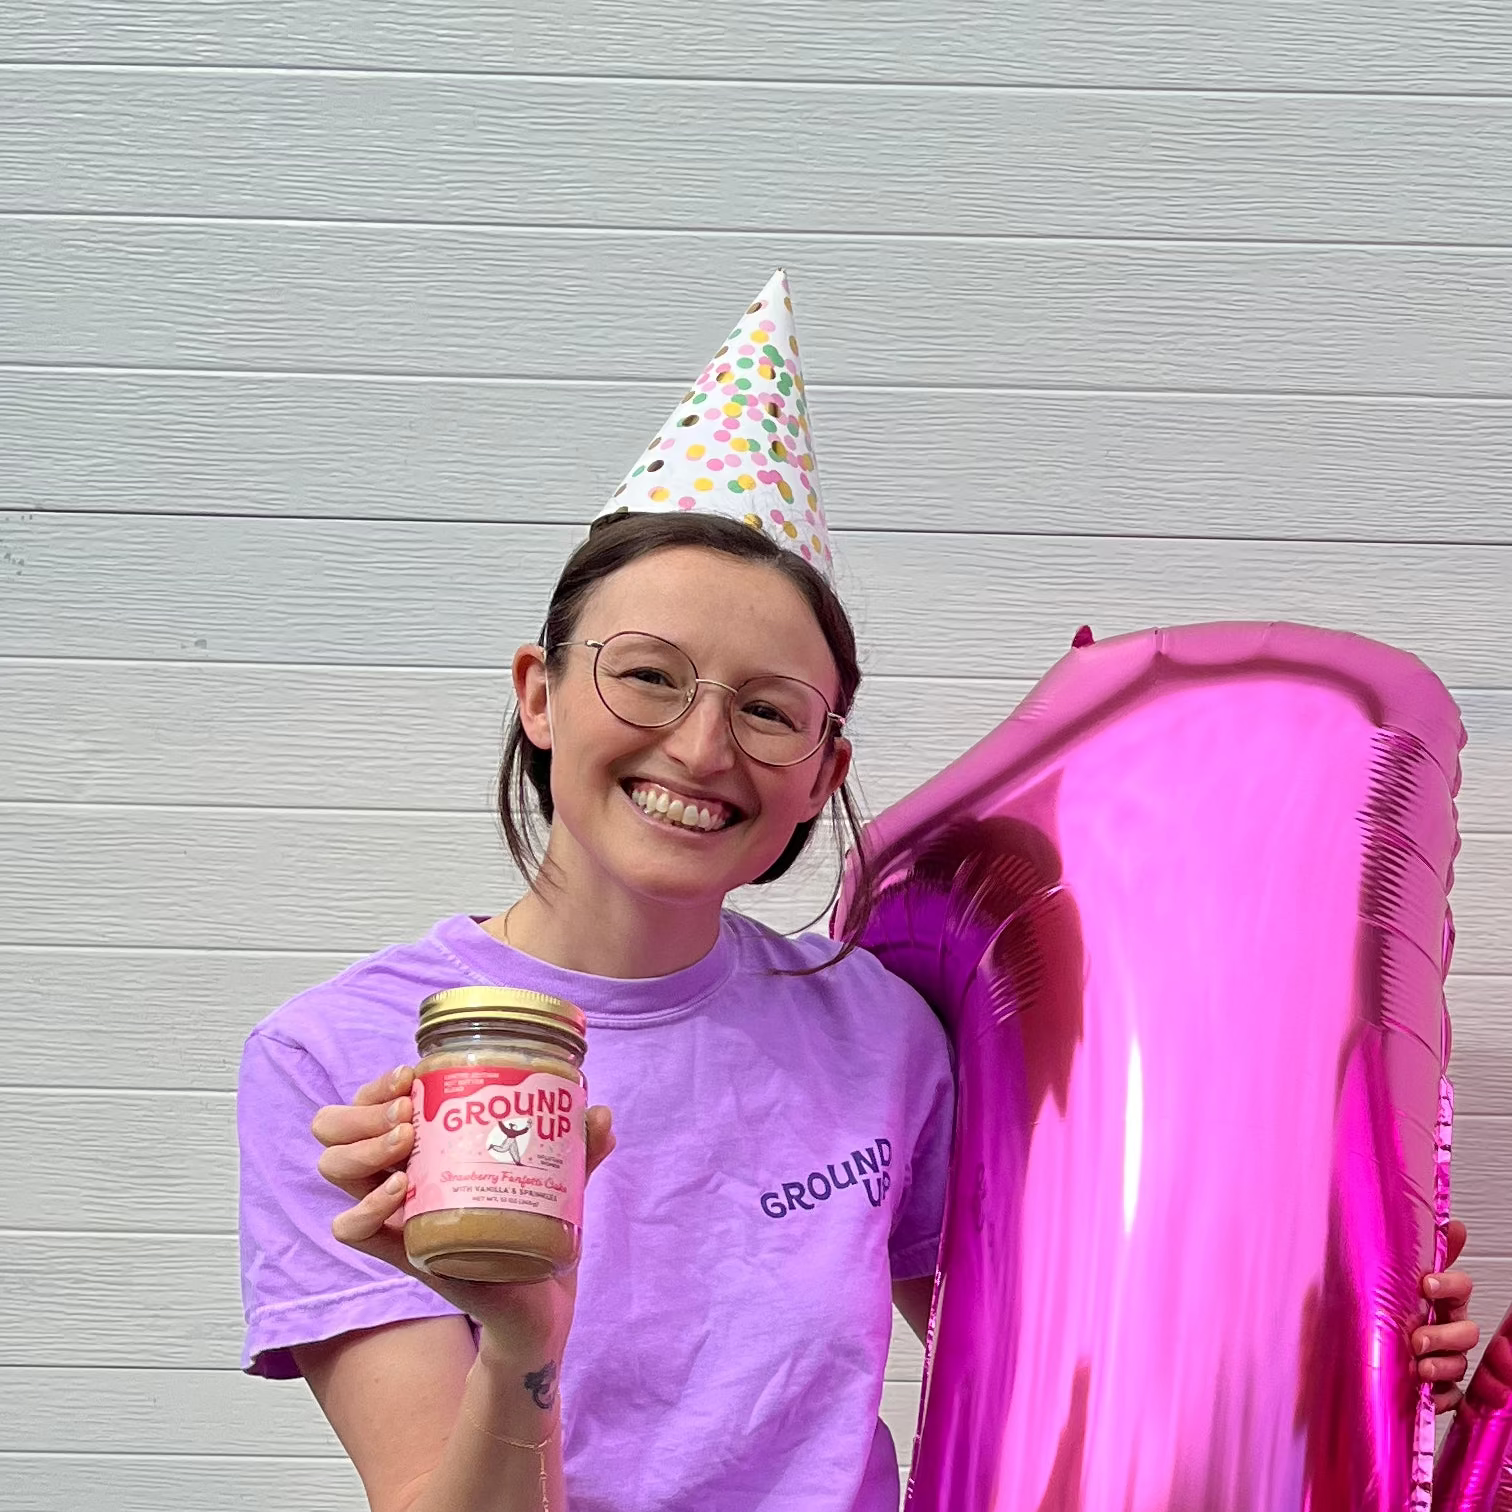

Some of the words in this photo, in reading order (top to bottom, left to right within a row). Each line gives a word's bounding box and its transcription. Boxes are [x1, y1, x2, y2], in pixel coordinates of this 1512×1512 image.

[443, 1087, 572, 1132] GROUND
[537, 1115, 571, 1142] UP
[760, 1138, 892, 1219] GROUND
[863, 1170, 891, 1207] UP
